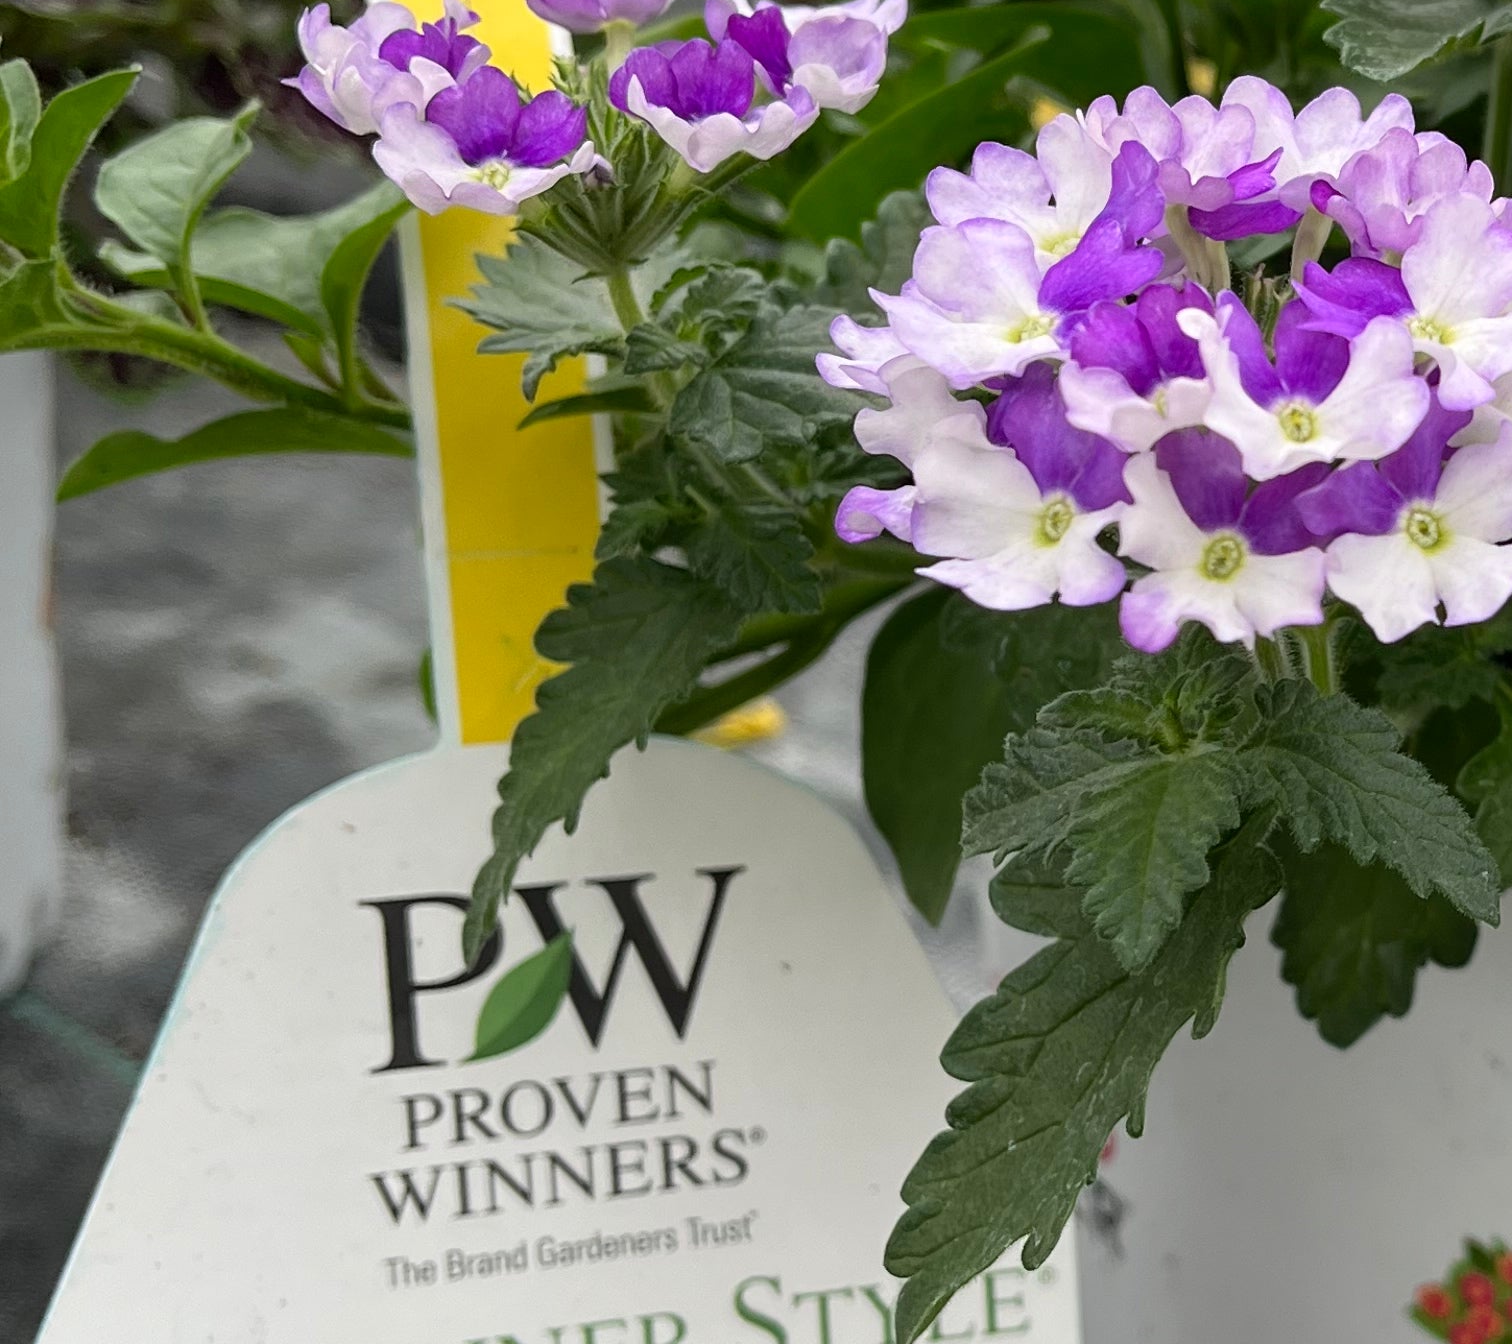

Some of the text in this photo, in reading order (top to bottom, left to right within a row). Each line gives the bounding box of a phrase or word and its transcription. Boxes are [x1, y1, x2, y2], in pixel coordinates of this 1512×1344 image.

[357, 863, 747, 1074] PW
[398, 1059, 716, 1153] PROVEN
[384, 1255, 438, 1290] The
[446, 1239, 528, 1283] Brand
[536, 1225, 679, 1269] Gardeners
